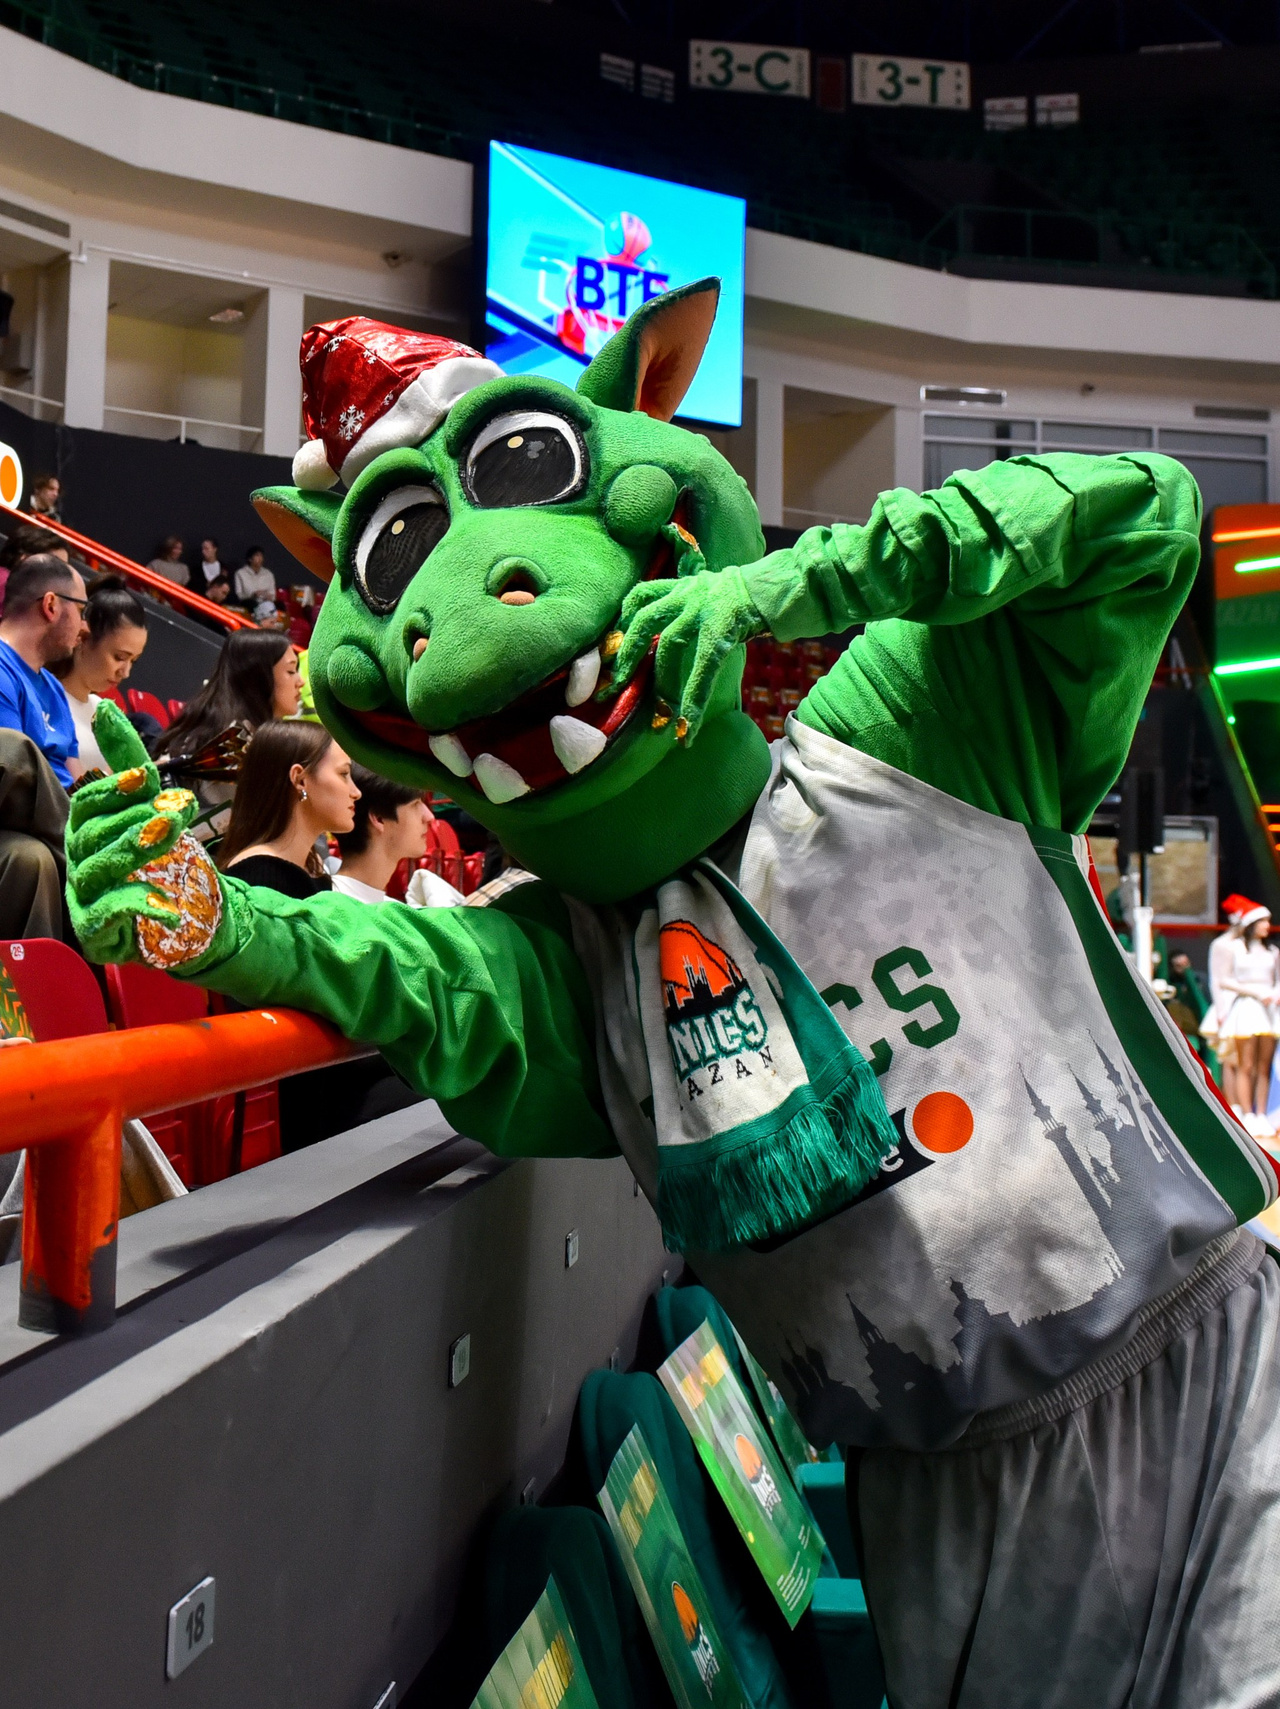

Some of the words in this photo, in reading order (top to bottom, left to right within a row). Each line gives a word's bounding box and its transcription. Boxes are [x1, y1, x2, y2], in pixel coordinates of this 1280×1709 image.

[669, 986, 768, 1082] NICS
[683, 1045, 774, 1103] AZAN
[186, 1601, 206, 1651] 18
